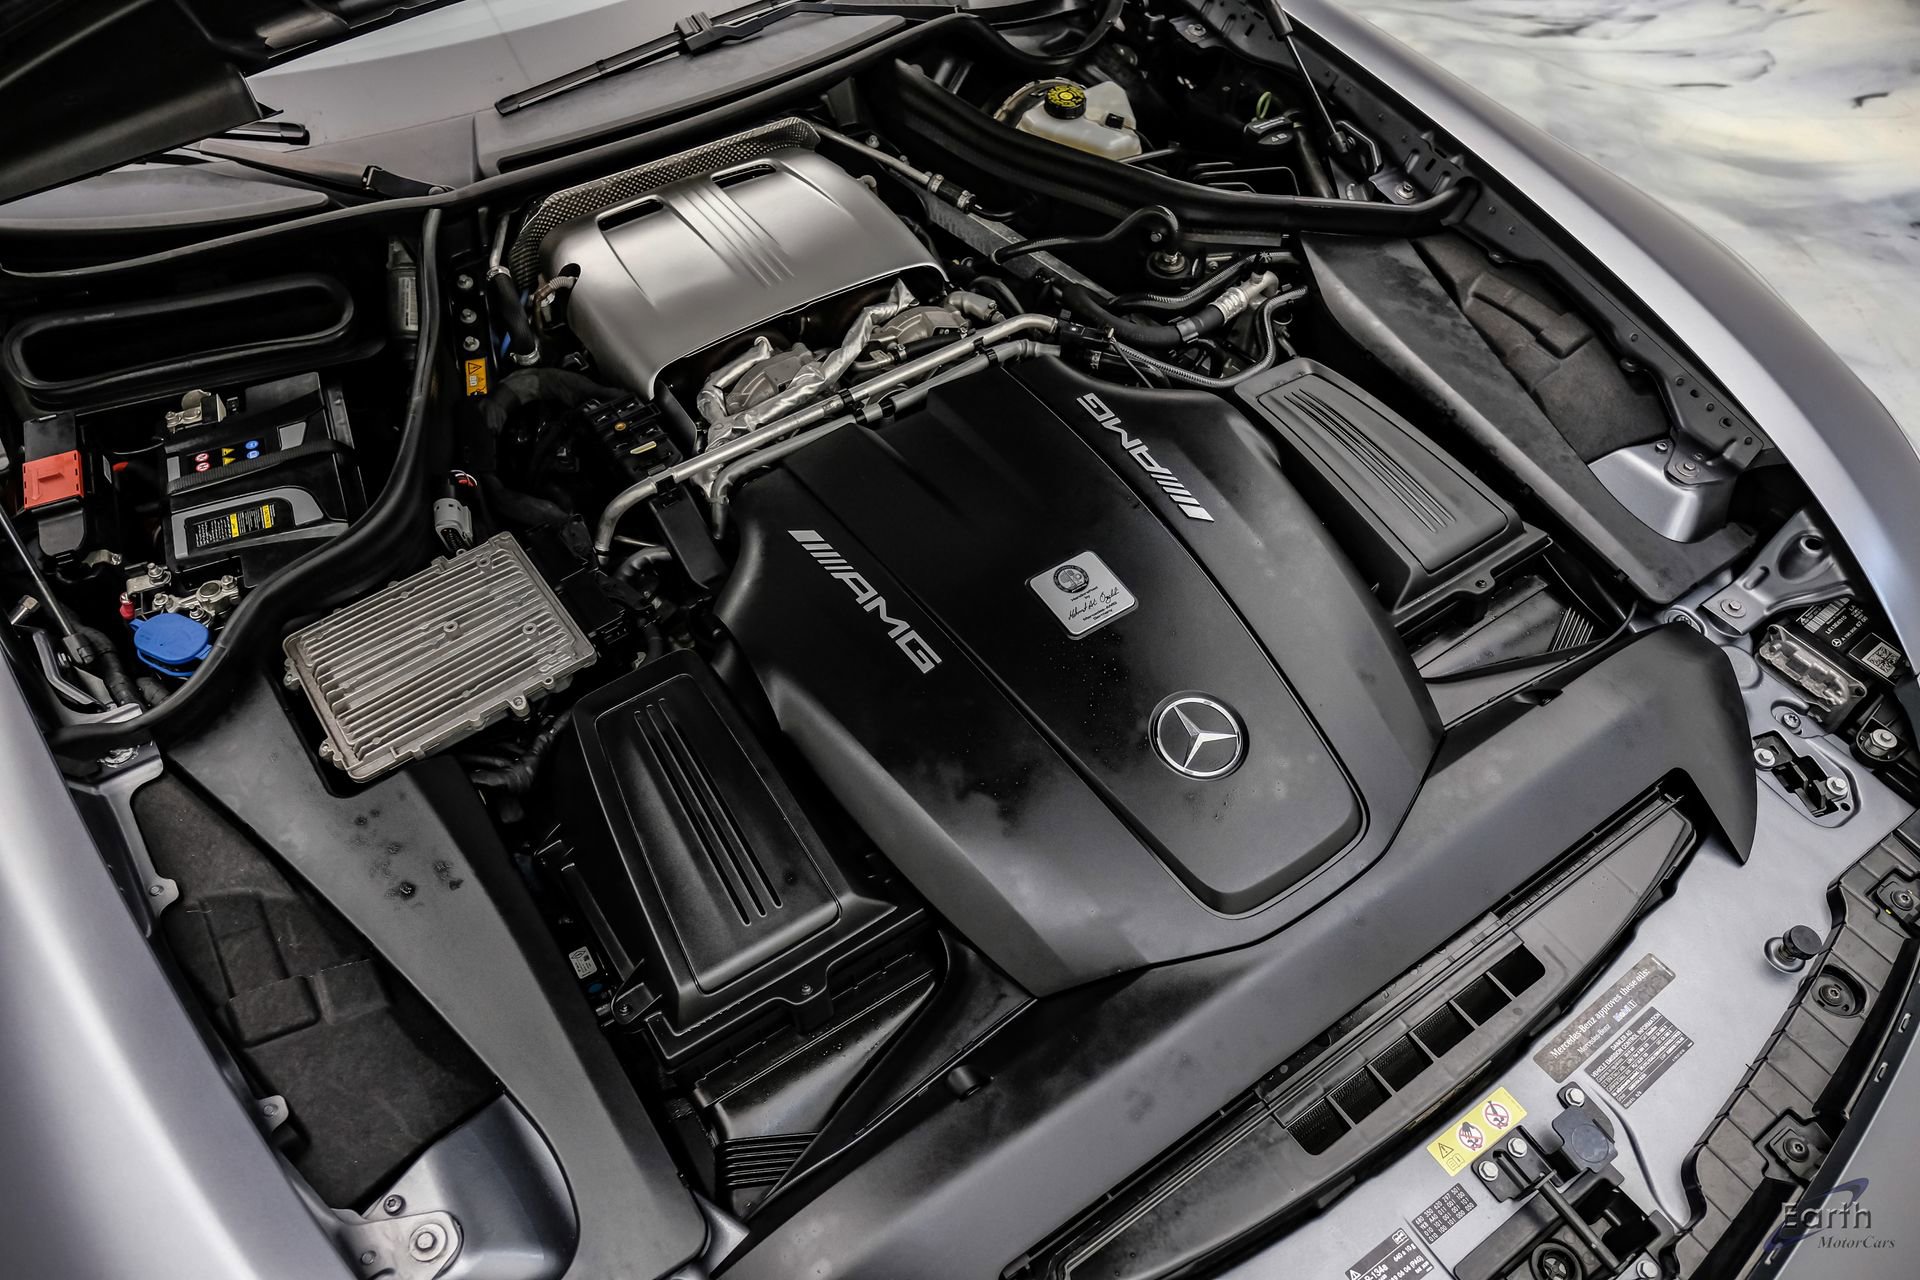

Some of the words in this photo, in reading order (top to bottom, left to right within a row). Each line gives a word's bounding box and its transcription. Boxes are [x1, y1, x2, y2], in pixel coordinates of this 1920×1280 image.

[1550, 1017, 1596, 1058] Mercedes-Benz
[1595, 994, 1622, 1019] approves
[1620, 980, 1637, 995] these
[1591, 1063, 1607, 1077] VEHICLE
[1605, 1048, 1623, 1065] EMISSION
[1621, 1034, 1639, 1049] CONTROL
[1637, 1012, 1661, 1034] INFORMATION
[1611, 1035, 1627, 1050] DAIMLER
